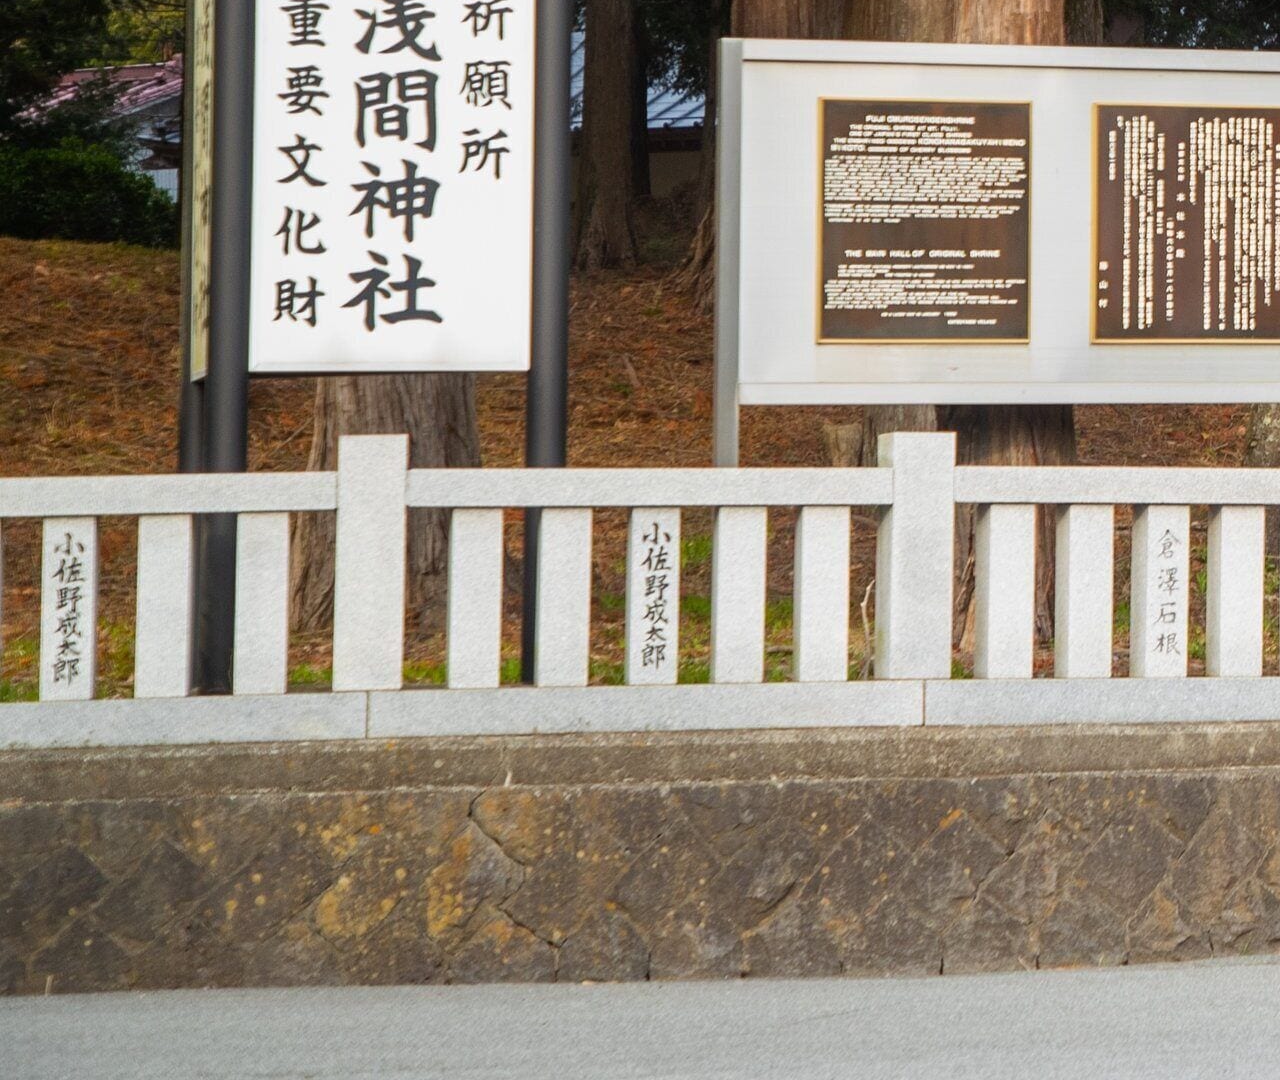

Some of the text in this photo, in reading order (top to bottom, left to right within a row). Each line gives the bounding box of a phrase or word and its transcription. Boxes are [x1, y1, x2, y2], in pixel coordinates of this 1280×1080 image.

[640, 521, 672, 670] 小佐野成太郎
